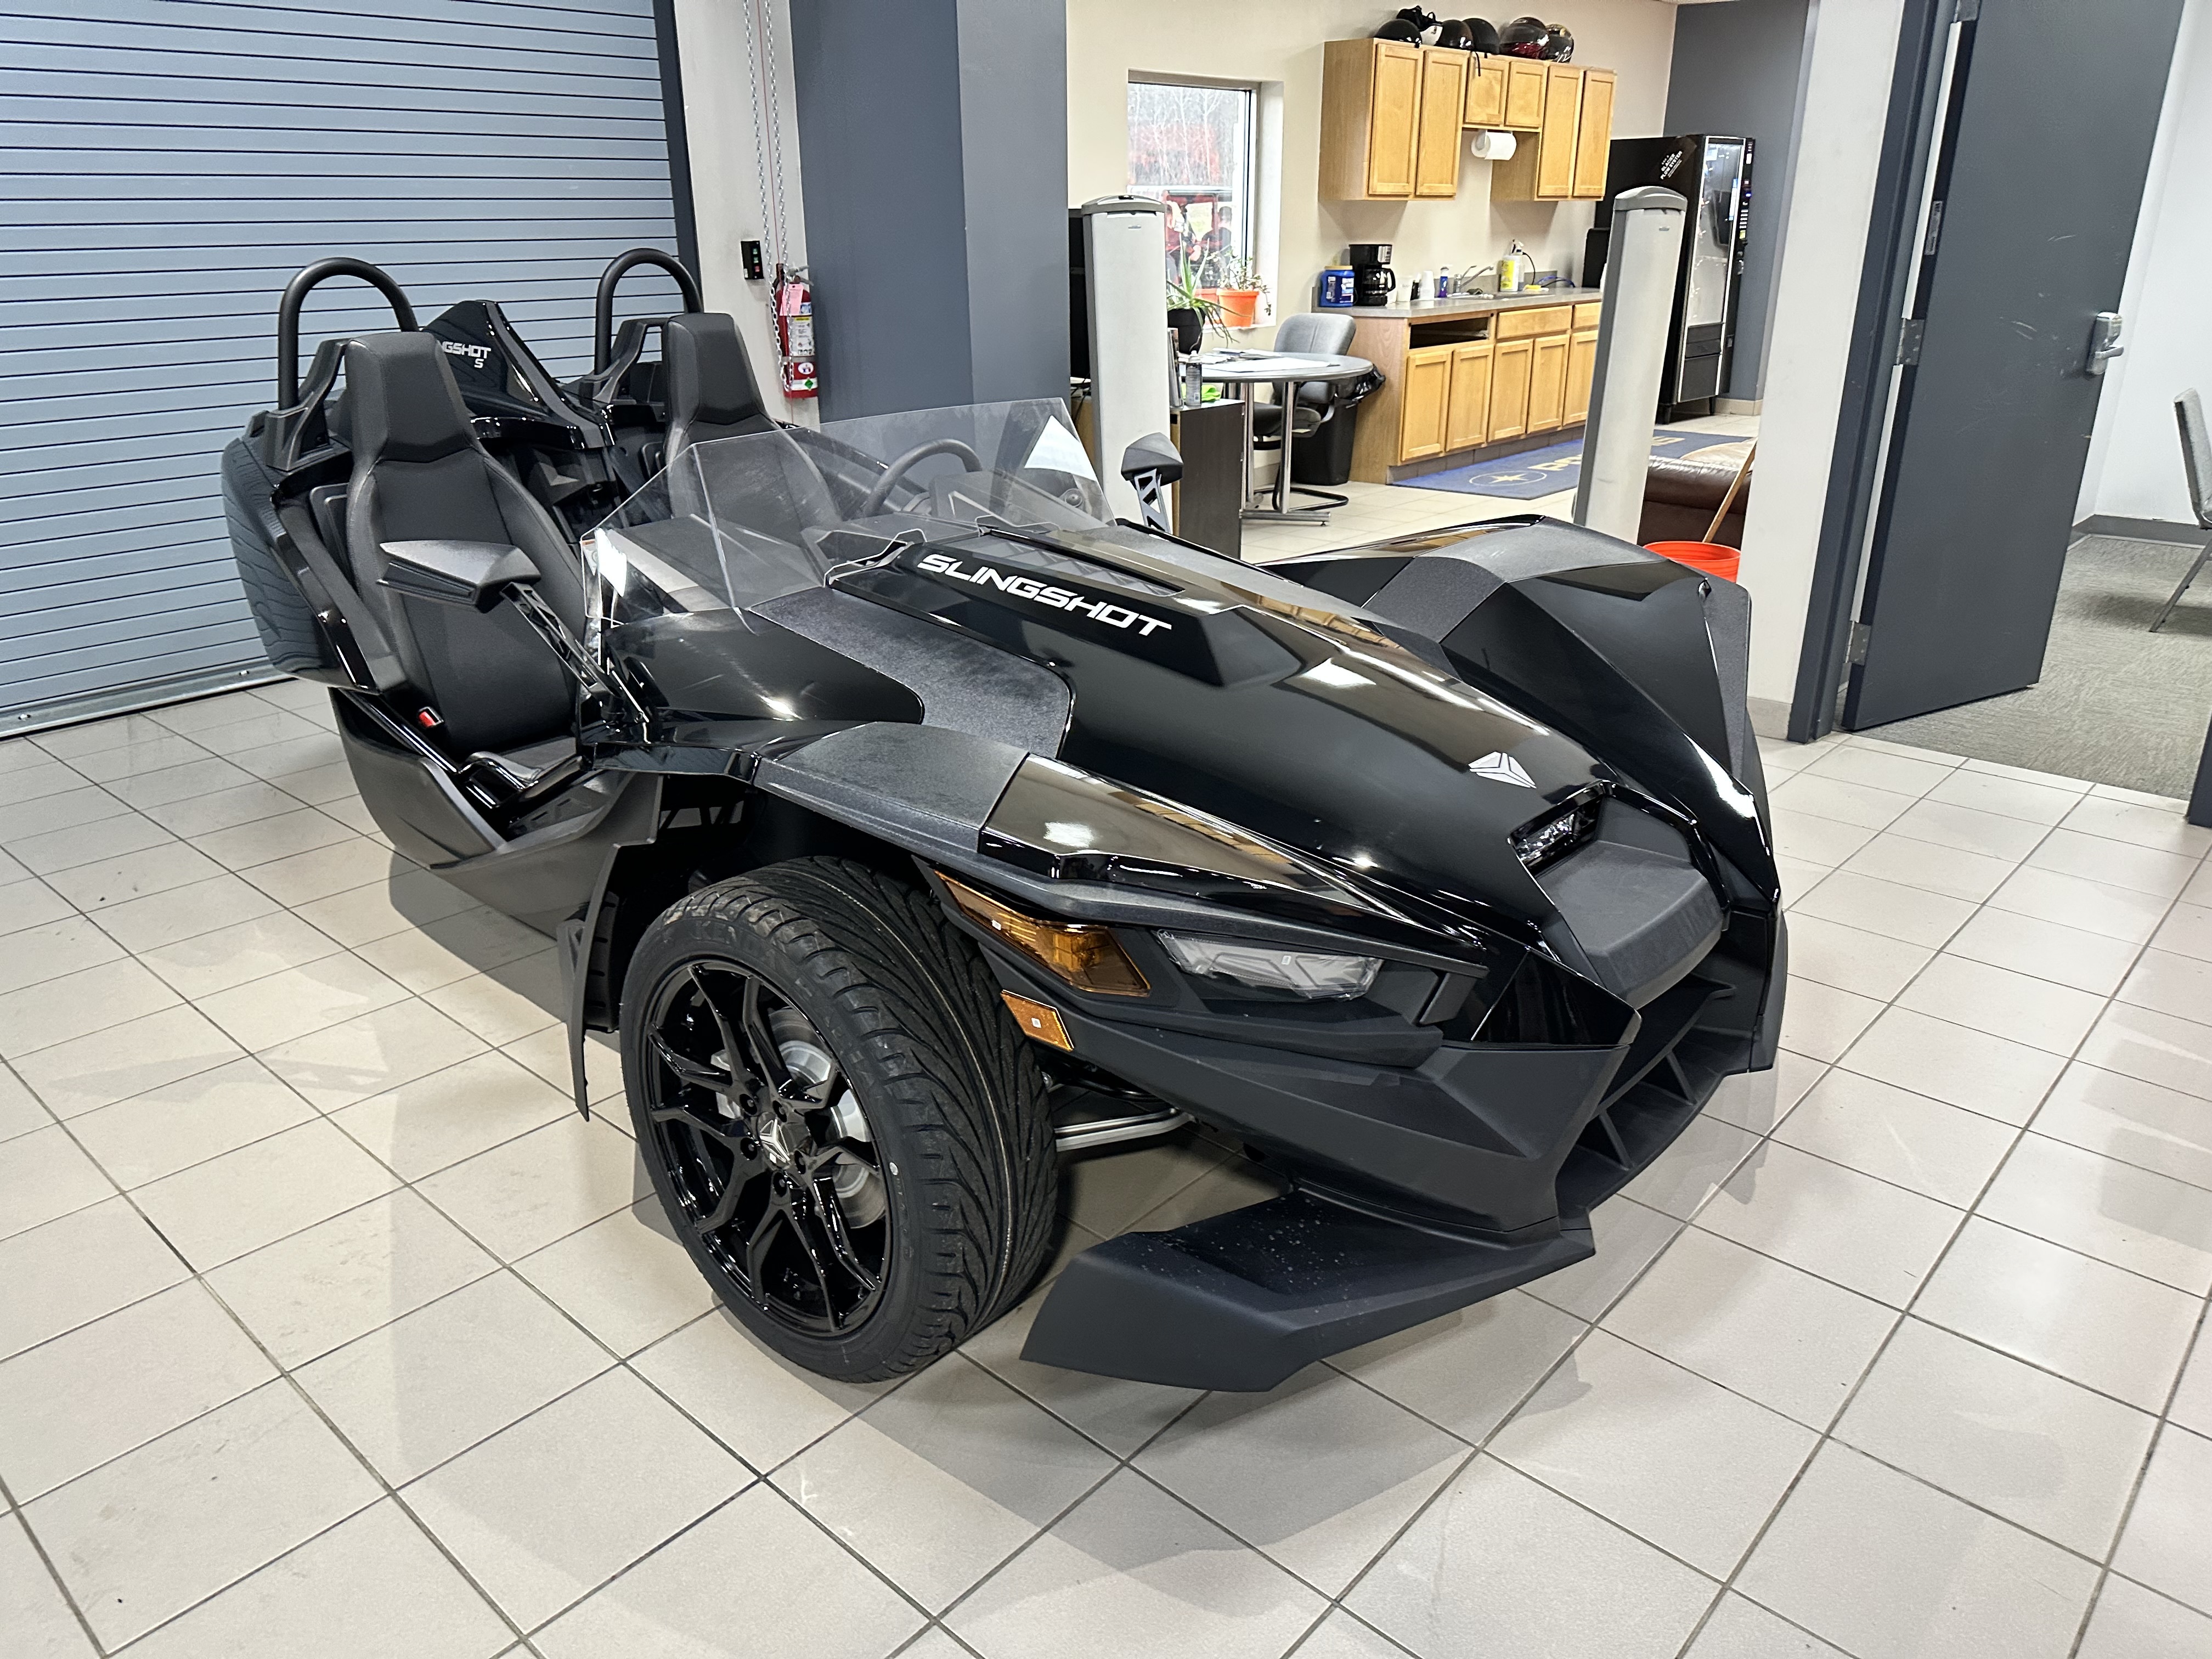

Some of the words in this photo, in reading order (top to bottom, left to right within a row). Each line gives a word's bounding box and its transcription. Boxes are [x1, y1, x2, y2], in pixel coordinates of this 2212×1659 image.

[442, 341, 491, 359] GSHOT
[474, 359, 484, 368] S
[917, 554, 1172, 636] SLINGSHOT
